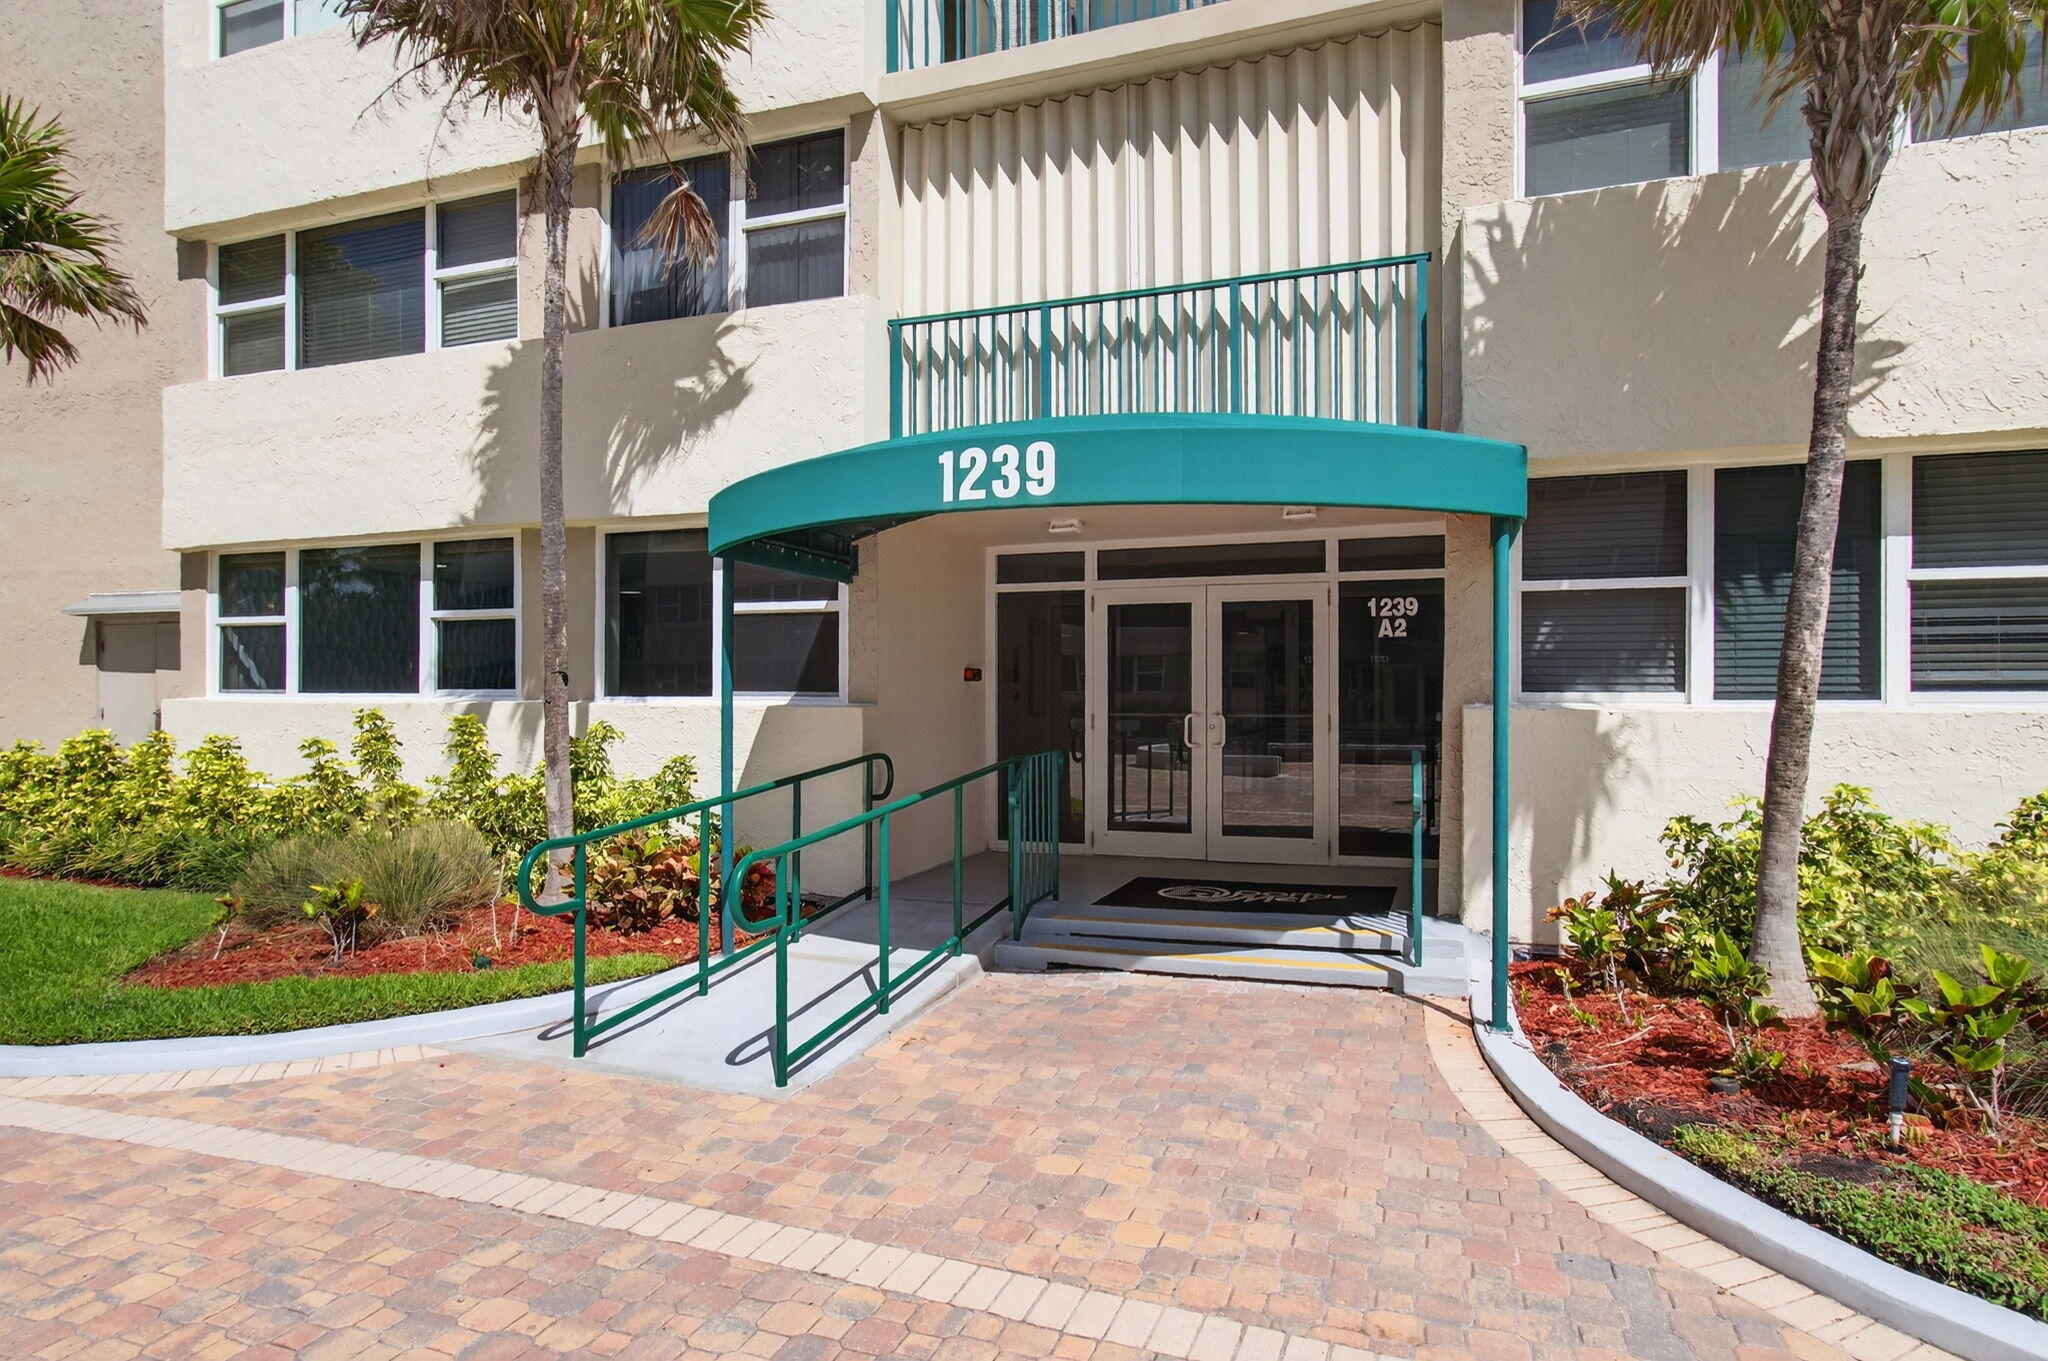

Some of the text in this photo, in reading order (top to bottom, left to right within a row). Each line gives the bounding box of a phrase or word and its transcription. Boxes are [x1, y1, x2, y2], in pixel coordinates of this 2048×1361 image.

[938, 441, 1056, 503] 1239
[1367, 596, 1419, 617] 1239
[1378, 618, 1408, 638] A2
